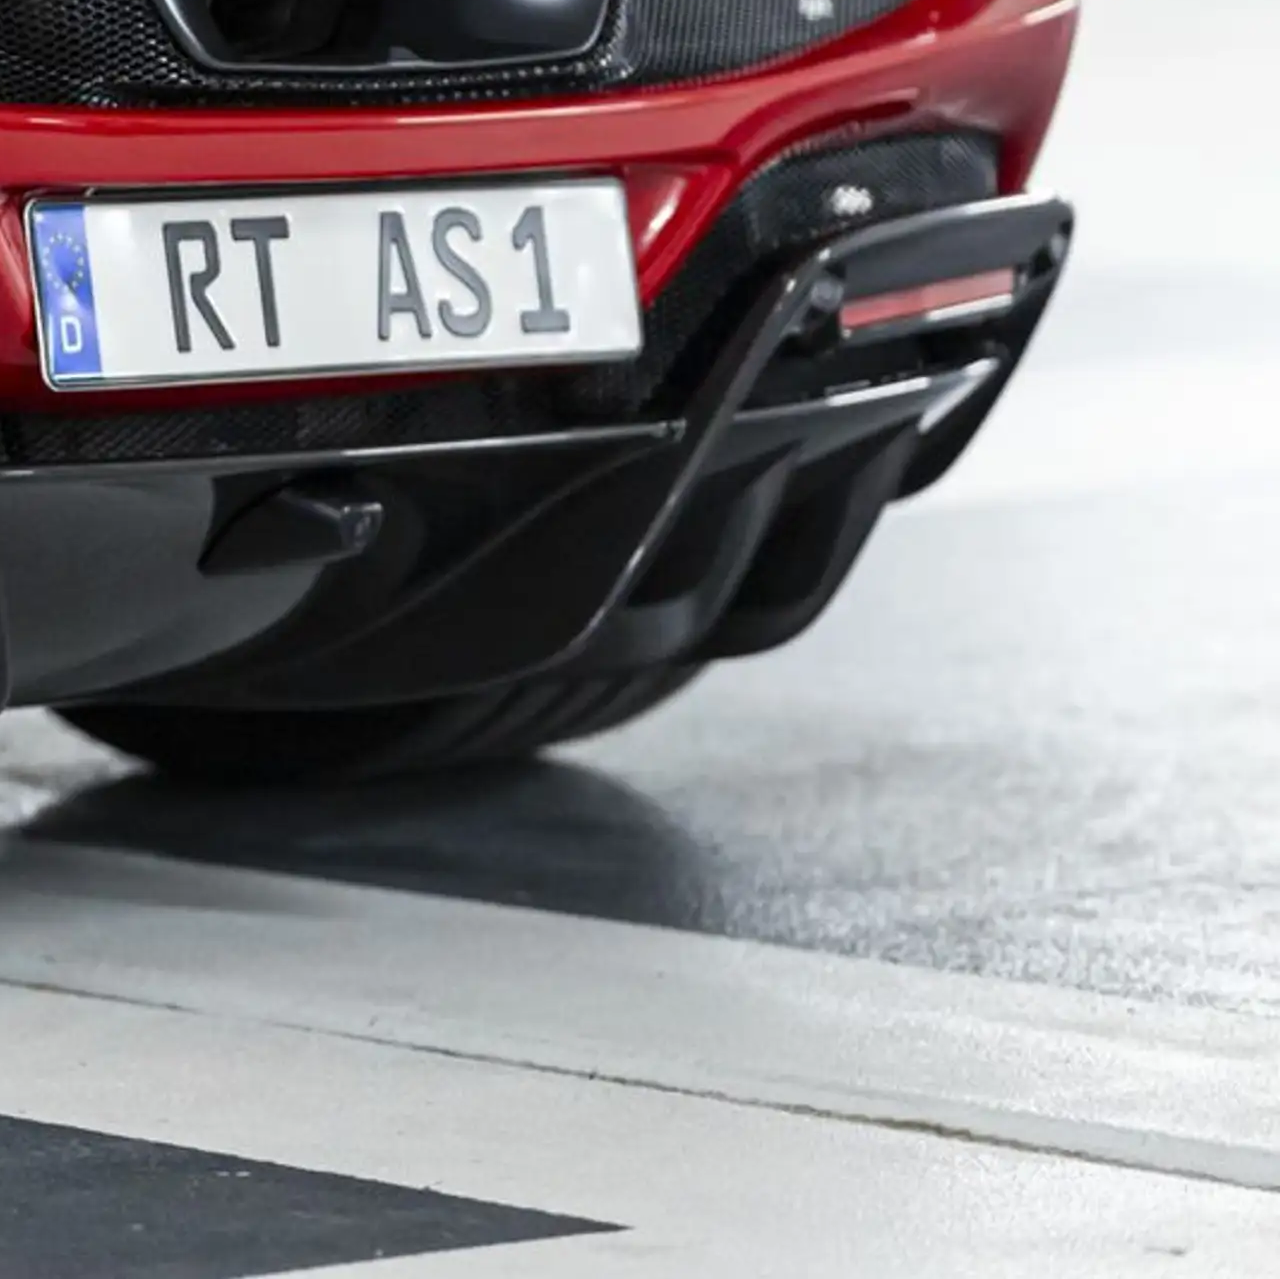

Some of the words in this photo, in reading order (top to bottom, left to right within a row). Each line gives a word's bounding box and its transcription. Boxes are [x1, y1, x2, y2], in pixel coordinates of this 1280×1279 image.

[160, 215, 290, 353] RT
[376, 205, 571, 342] AS1
[60, 314, 86, 355] D
